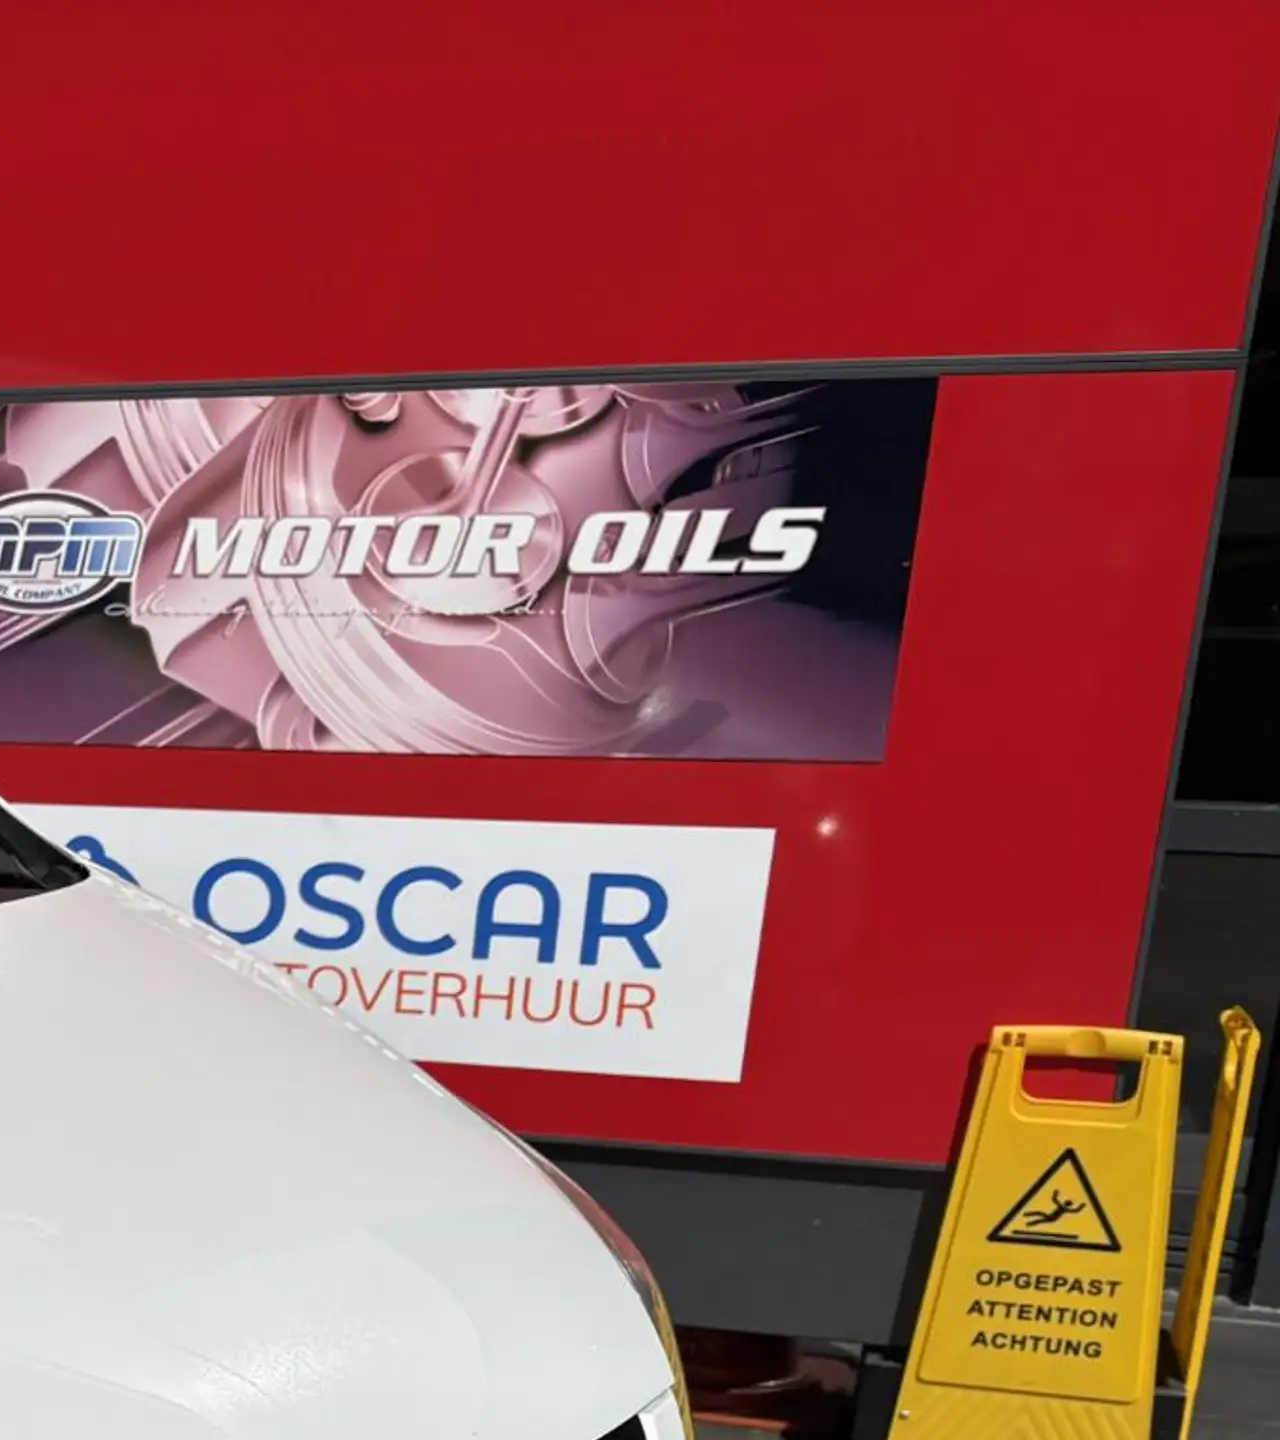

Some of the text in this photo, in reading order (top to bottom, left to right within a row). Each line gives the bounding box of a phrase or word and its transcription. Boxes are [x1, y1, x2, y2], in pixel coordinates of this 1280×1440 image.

[171, 506, 829, 578] MOTOR OILS
[192, 856, 669, 969] OSCAR
[975, 1268, 1123, 1298] OPGEPAST
[966, 1299, 1119, 1330] ATTENTION
[970, 1331, 1103, 1359] ACHTUNG
